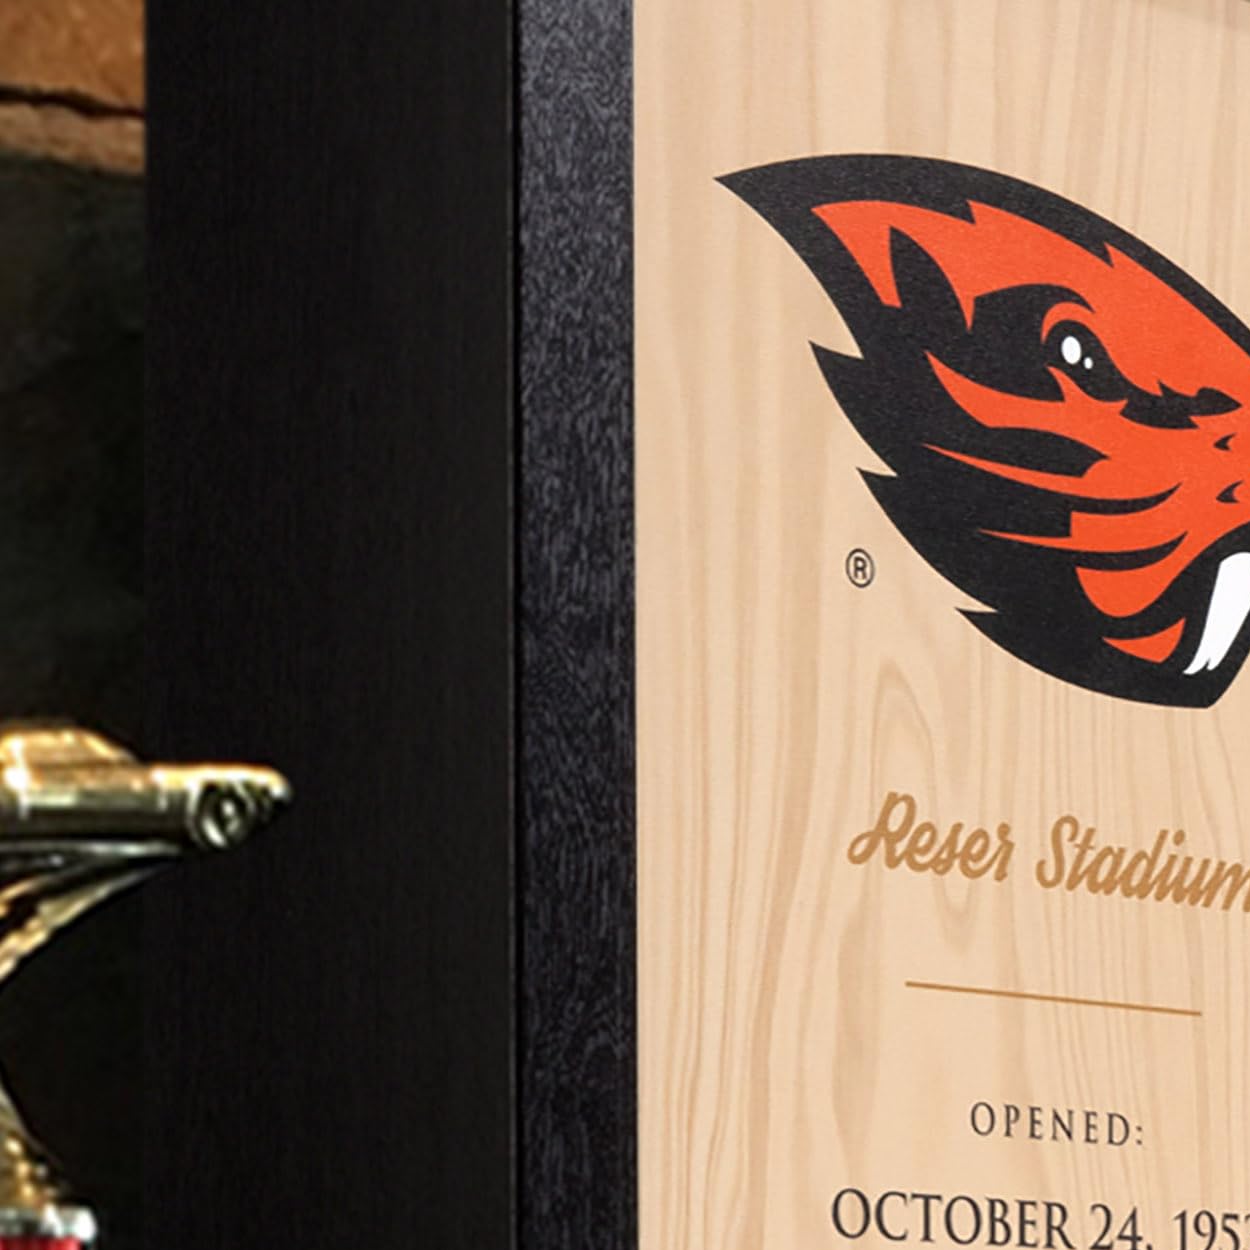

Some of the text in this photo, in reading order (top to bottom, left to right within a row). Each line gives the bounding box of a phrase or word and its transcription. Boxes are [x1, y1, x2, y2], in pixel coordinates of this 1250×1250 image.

[849, 793, 1015, 882] Reser
[972, 1103, 1143, 1146] OPENED:
[833, 1189, 1076, 1250] OCTOBER
